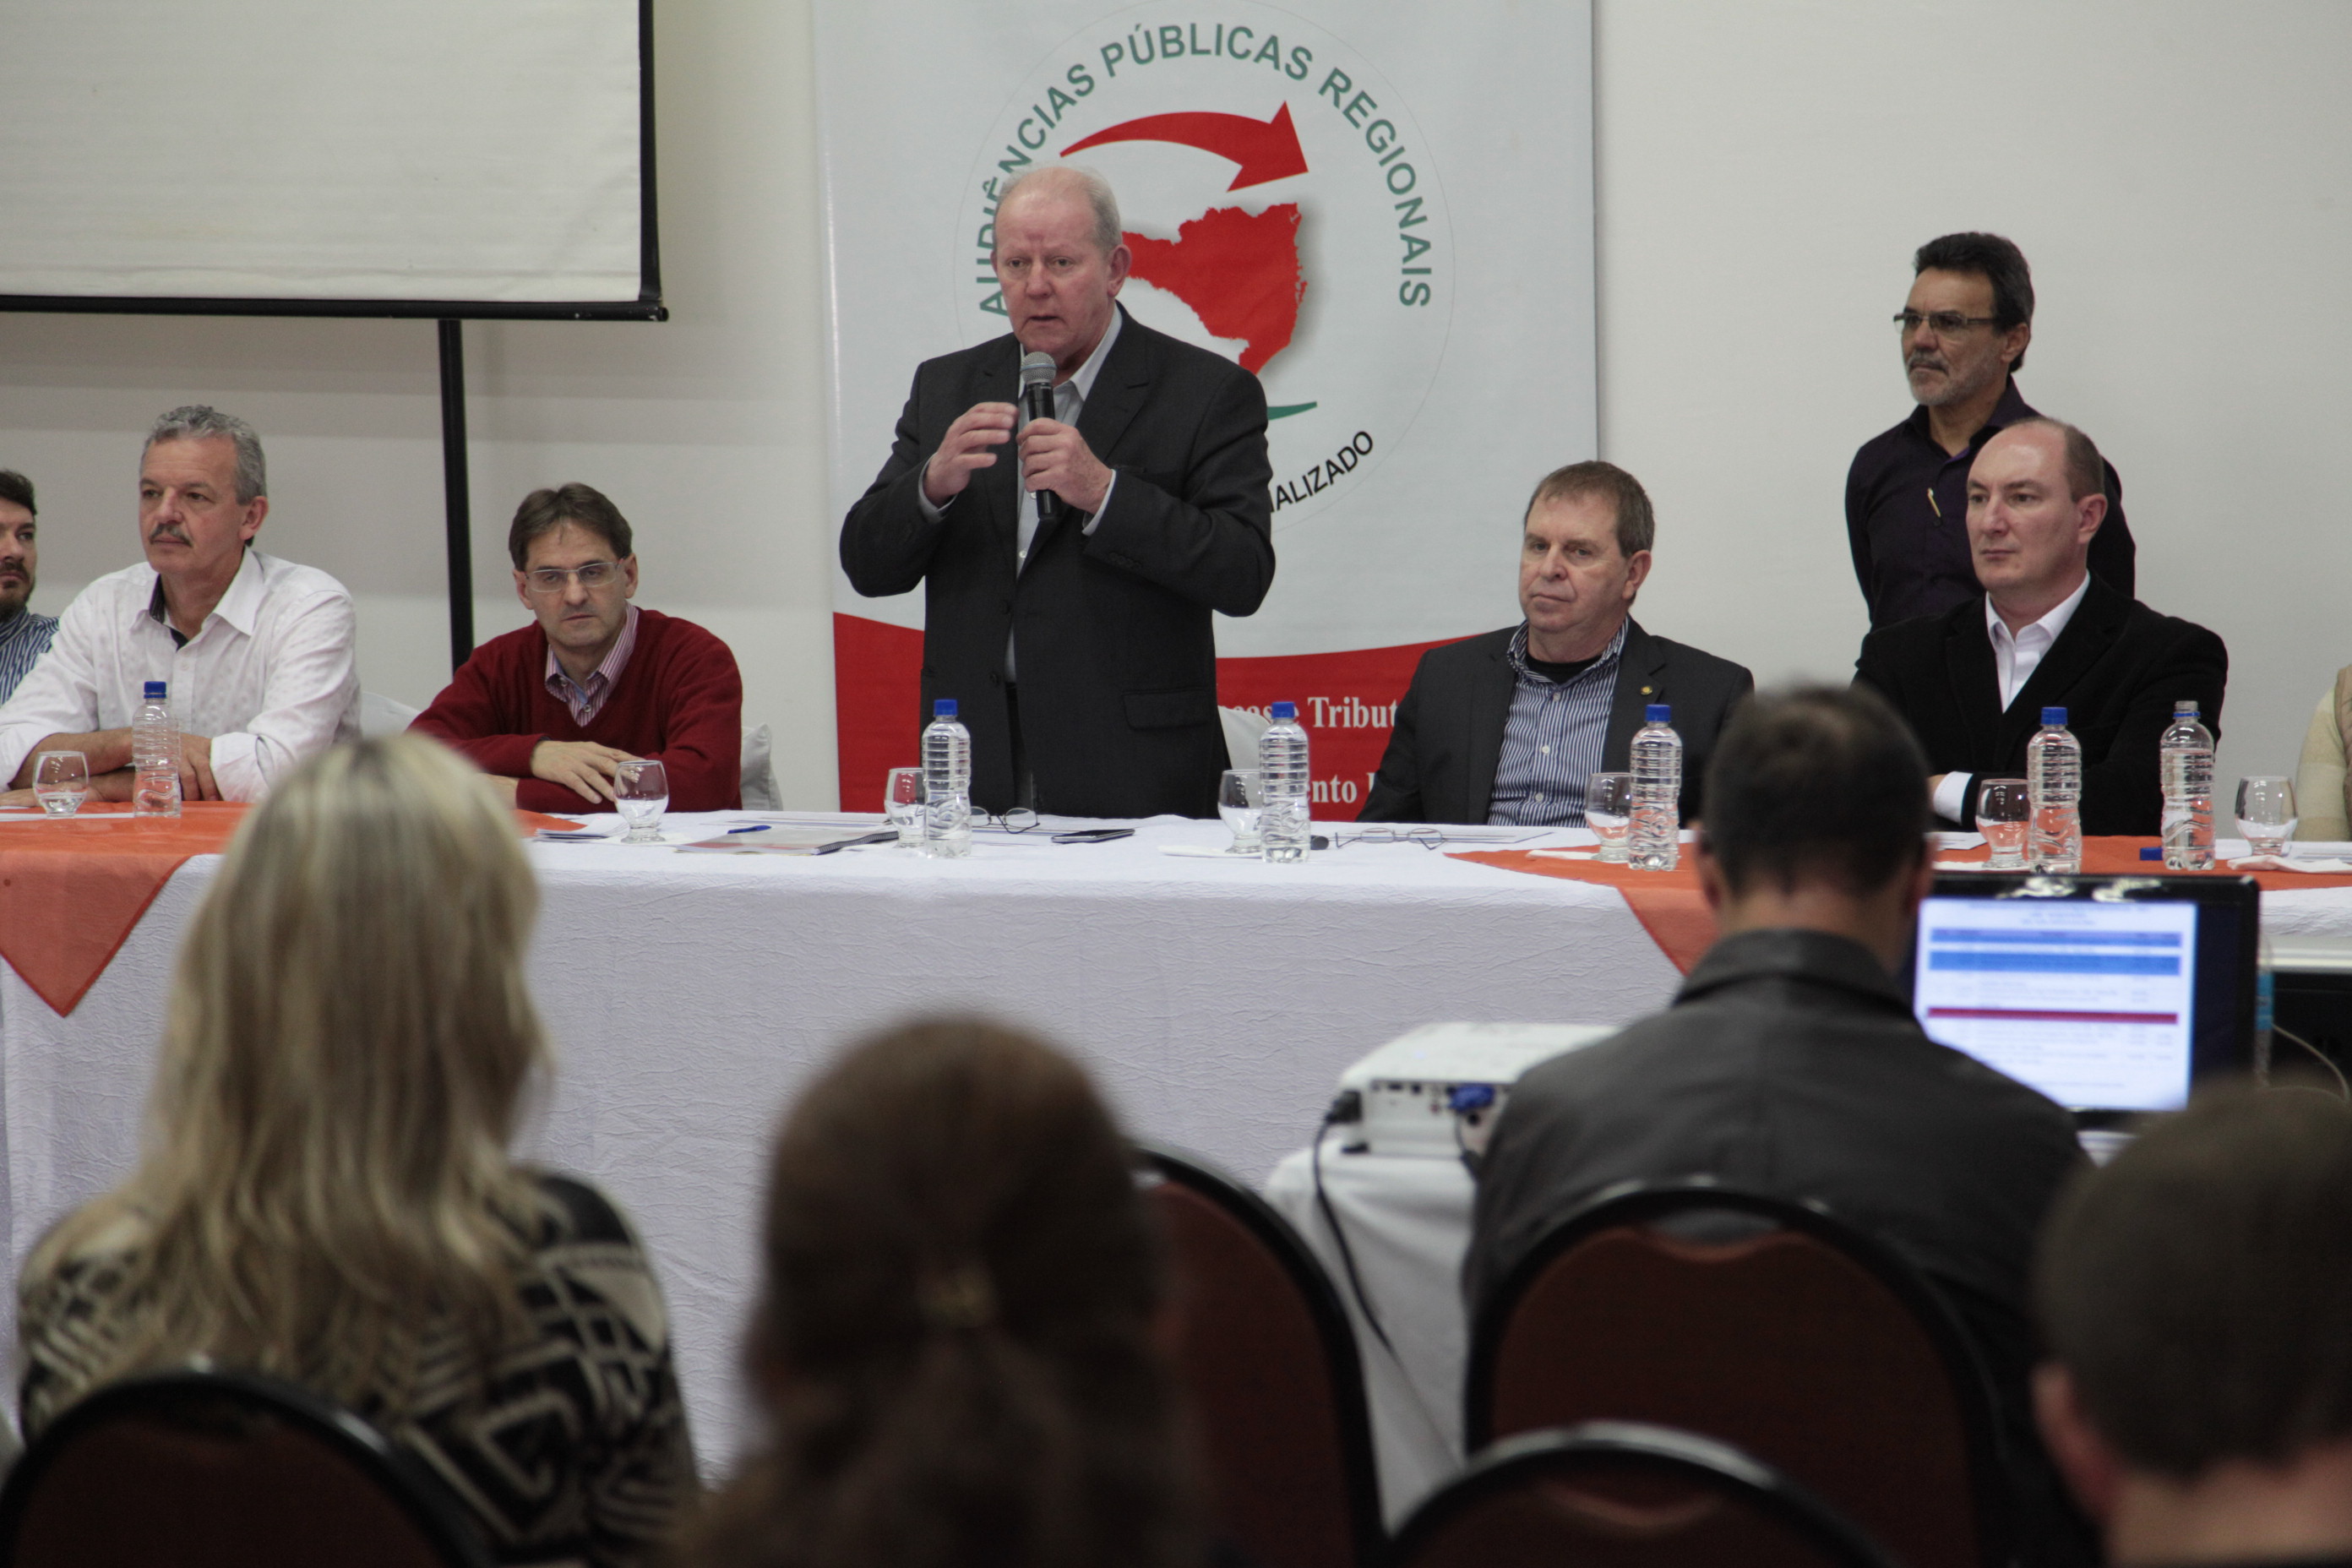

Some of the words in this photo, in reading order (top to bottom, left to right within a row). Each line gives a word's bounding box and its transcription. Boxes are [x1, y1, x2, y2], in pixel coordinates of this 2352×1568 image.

[1099, 23, 1313, 82] PÚBLICAS
[1317, 68, 1432, 308] REGIONAIS
[1268, 430, 1374, 514] ALIZADO
[1307, 696, 1399, 728] Tribut
